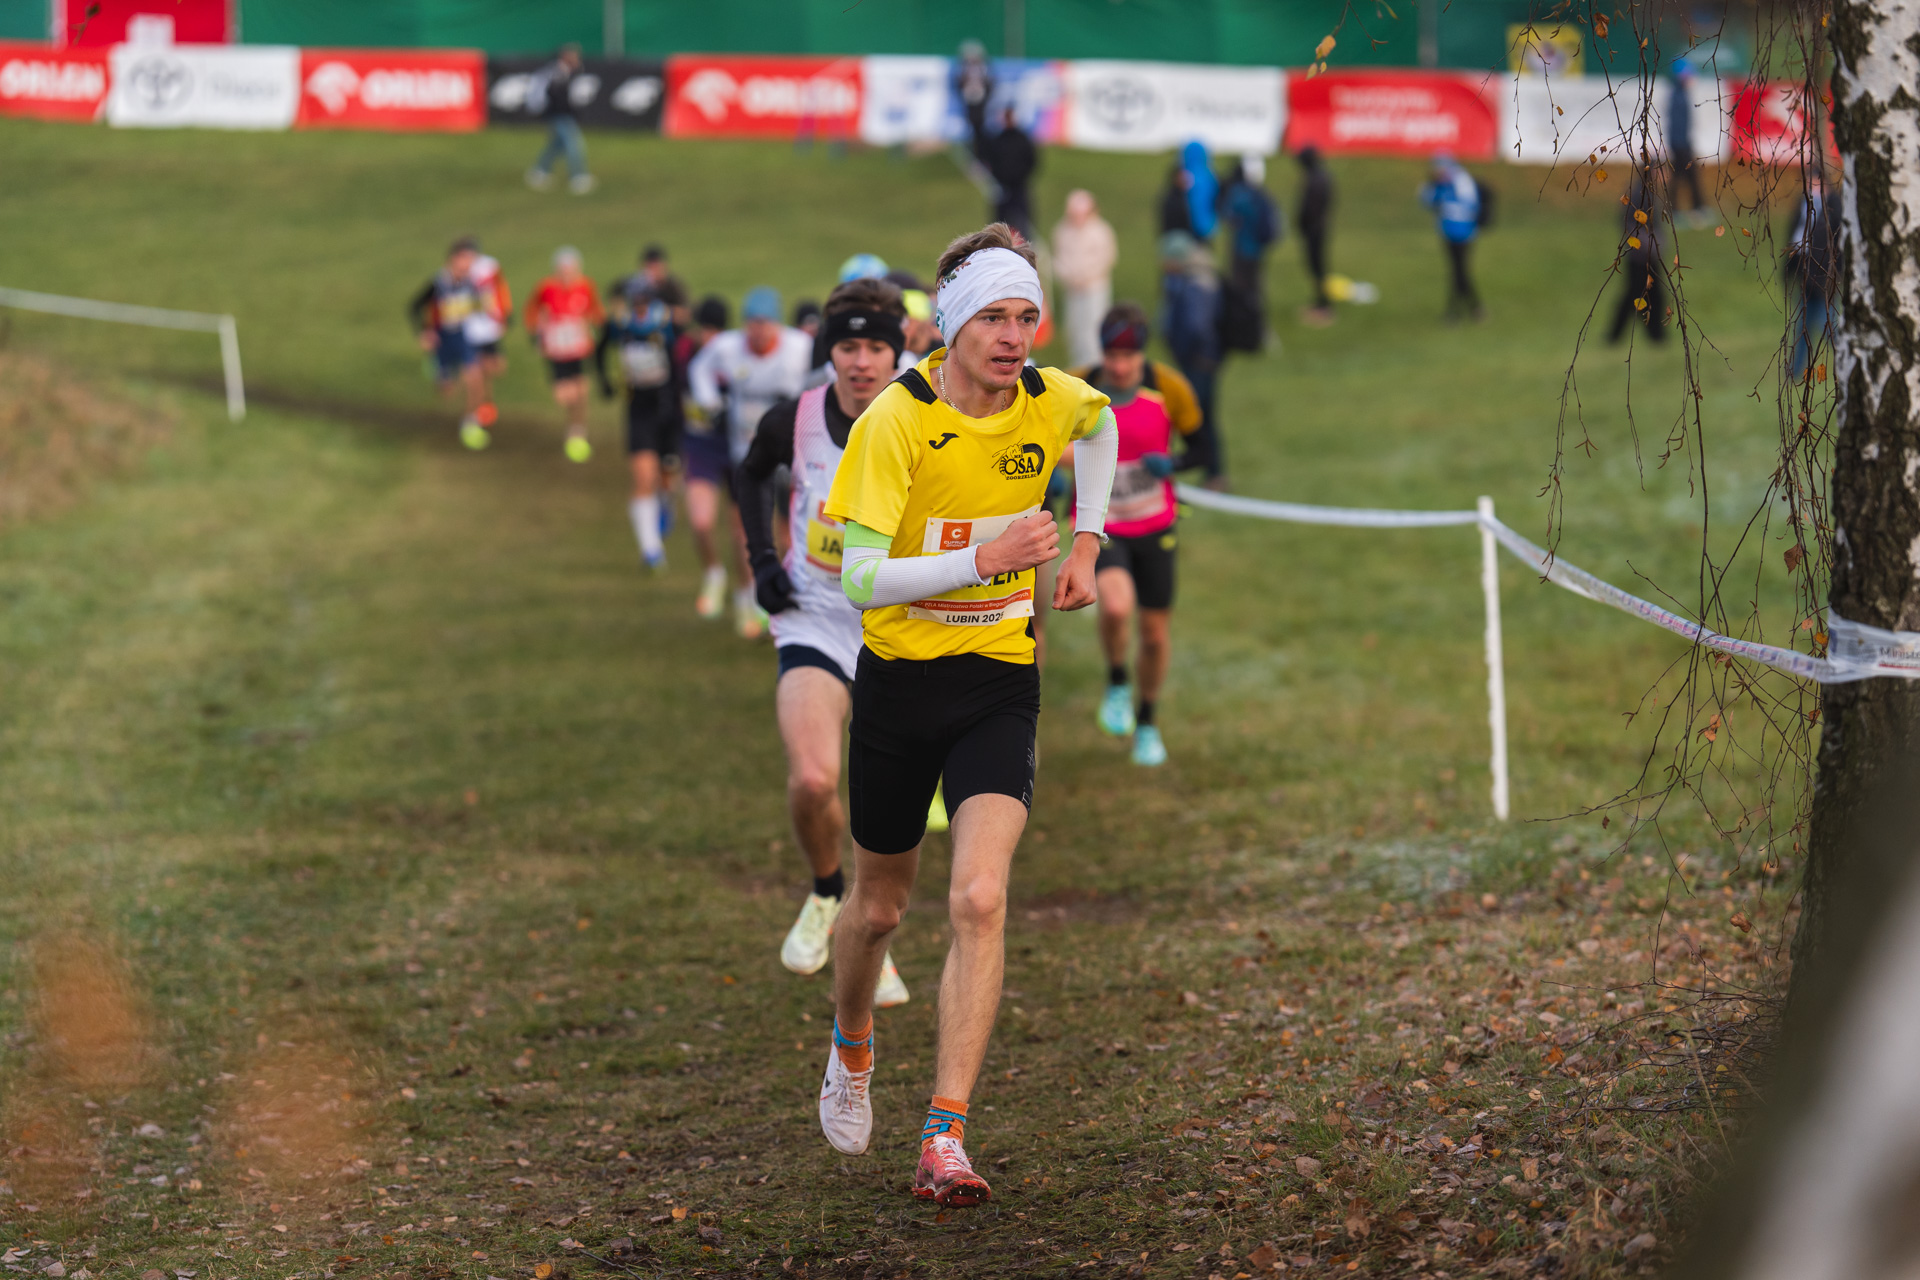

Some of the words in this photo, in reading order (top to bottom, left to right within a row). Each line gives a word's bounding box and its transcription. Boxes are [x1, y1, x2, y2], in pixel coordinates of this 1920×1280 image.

[1005, 457, 1036, 475] OSA
[821, 536, 843, 557] JA
[946, 615, 979, 623] LUBIN
